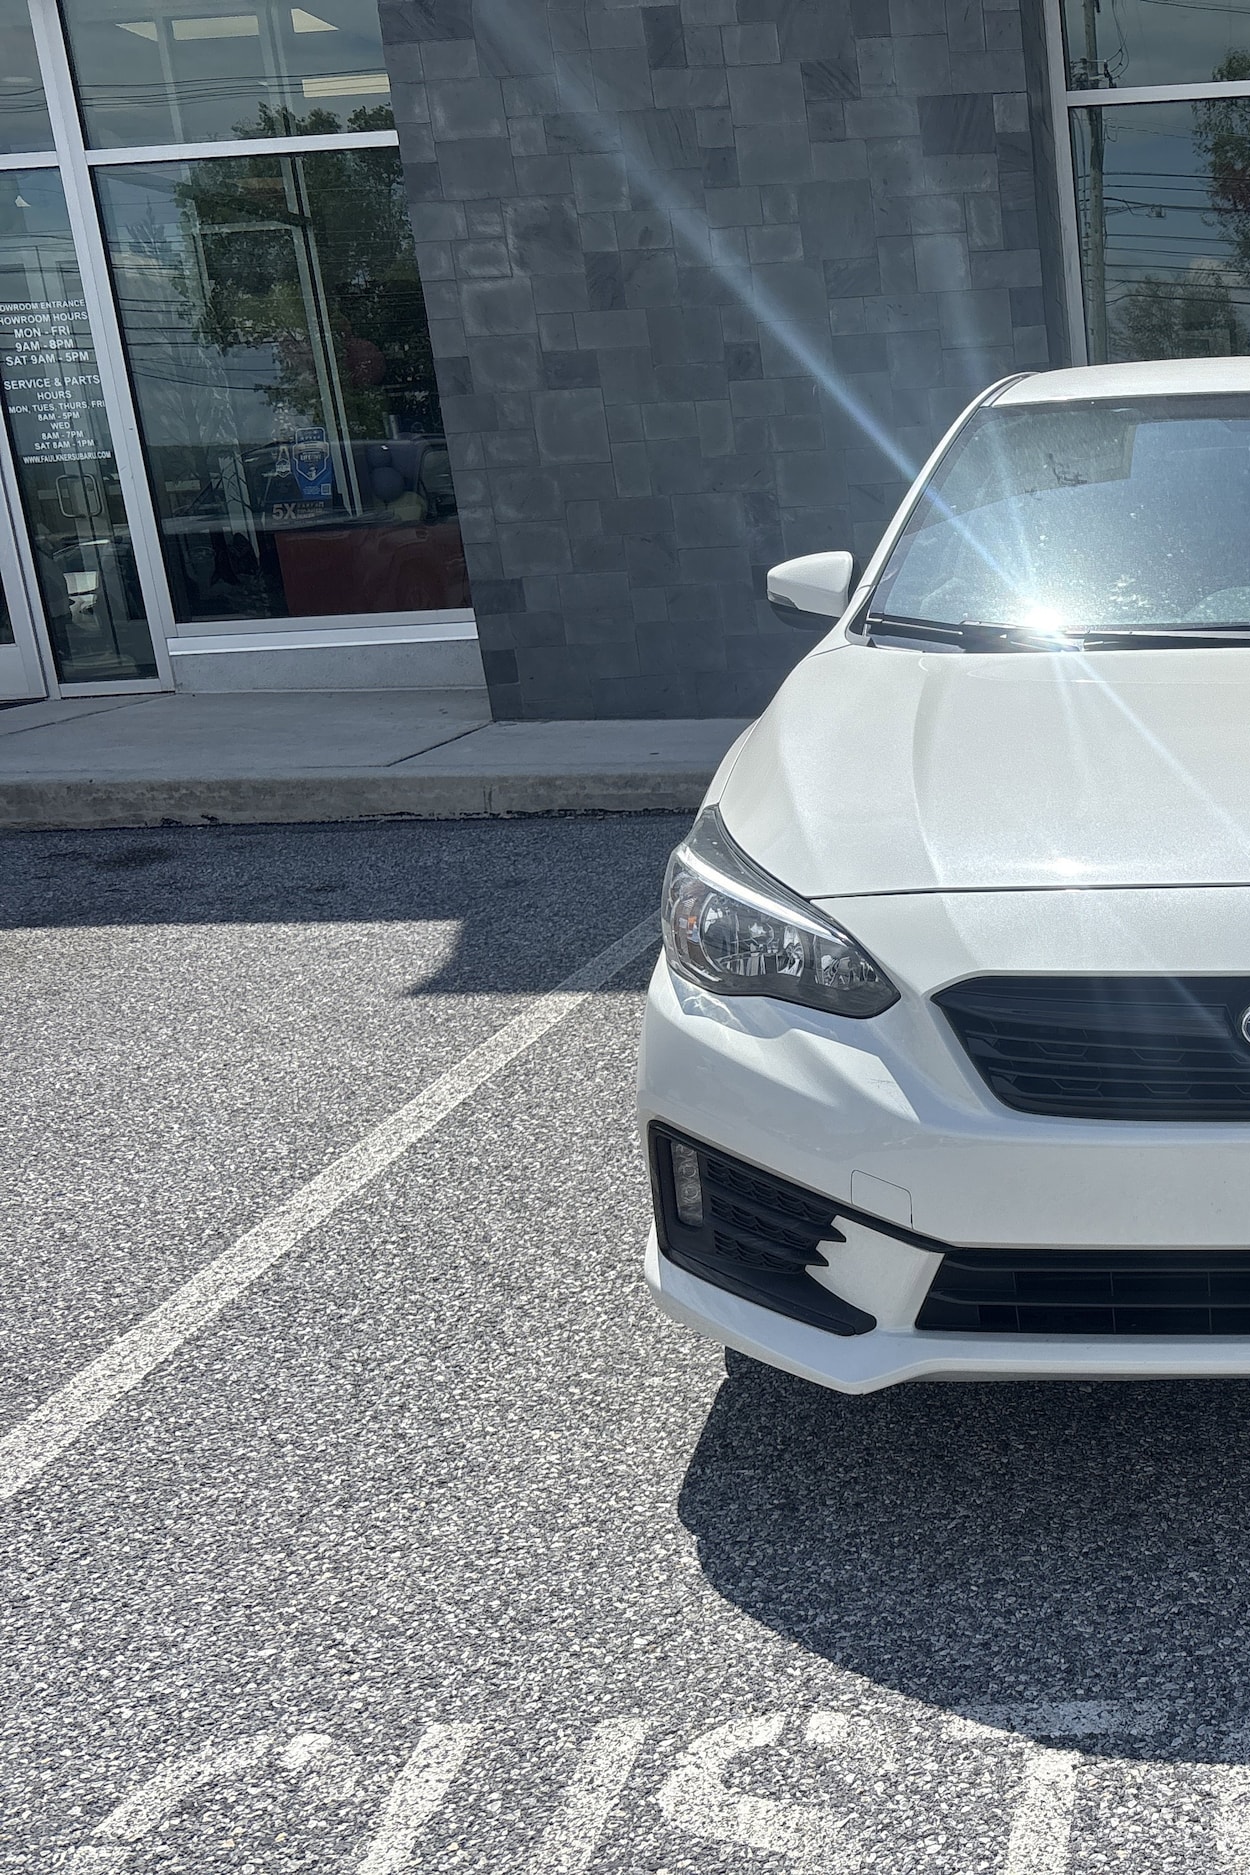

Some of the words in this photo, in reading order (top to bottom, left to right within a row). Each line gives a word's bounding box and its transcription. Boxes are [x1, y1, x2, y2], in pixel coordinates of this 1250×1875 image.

[40, 299, 86, 309] ENTRANCE
[53, 311, 89, 322] HOURS
[14, 327, 41, 338] MON
[51, 325, 71, 336] FRI
[15, 341, 40, 352] 9AM
[49, 339, 74, 349] 8PM
[5, 355, 28, 366] SAT
[30, 353, 56, 364] 9AM
[65, 351, 89, 362] 5PM
[4, 378, 51, 390] SERVICE
[54, 378, 62, 387] &
[64, 375, 100, 386] PARTS
[37, 390, 72, 400] HOURS
[8, 405, 31, 414] MON,
[32, 403, 57, 412] TUES,
[59, 401, 90, 410] THURS,
[91, 400, 106, 408] FRI
[38, 413, 56, 421] 8AM
[62, 411, 80, 420] 5PM
[50, 421, 70, 430] WED
[41, 432, 60, 440] 8AM
[66, 430, 84, 438] 7PM
[34, 442, 51, 450] SAT
[53, 441, 71, 449] 8AM
[77, 439, 95, 448] 1PM
[272, 503, 297, 520] 5X
